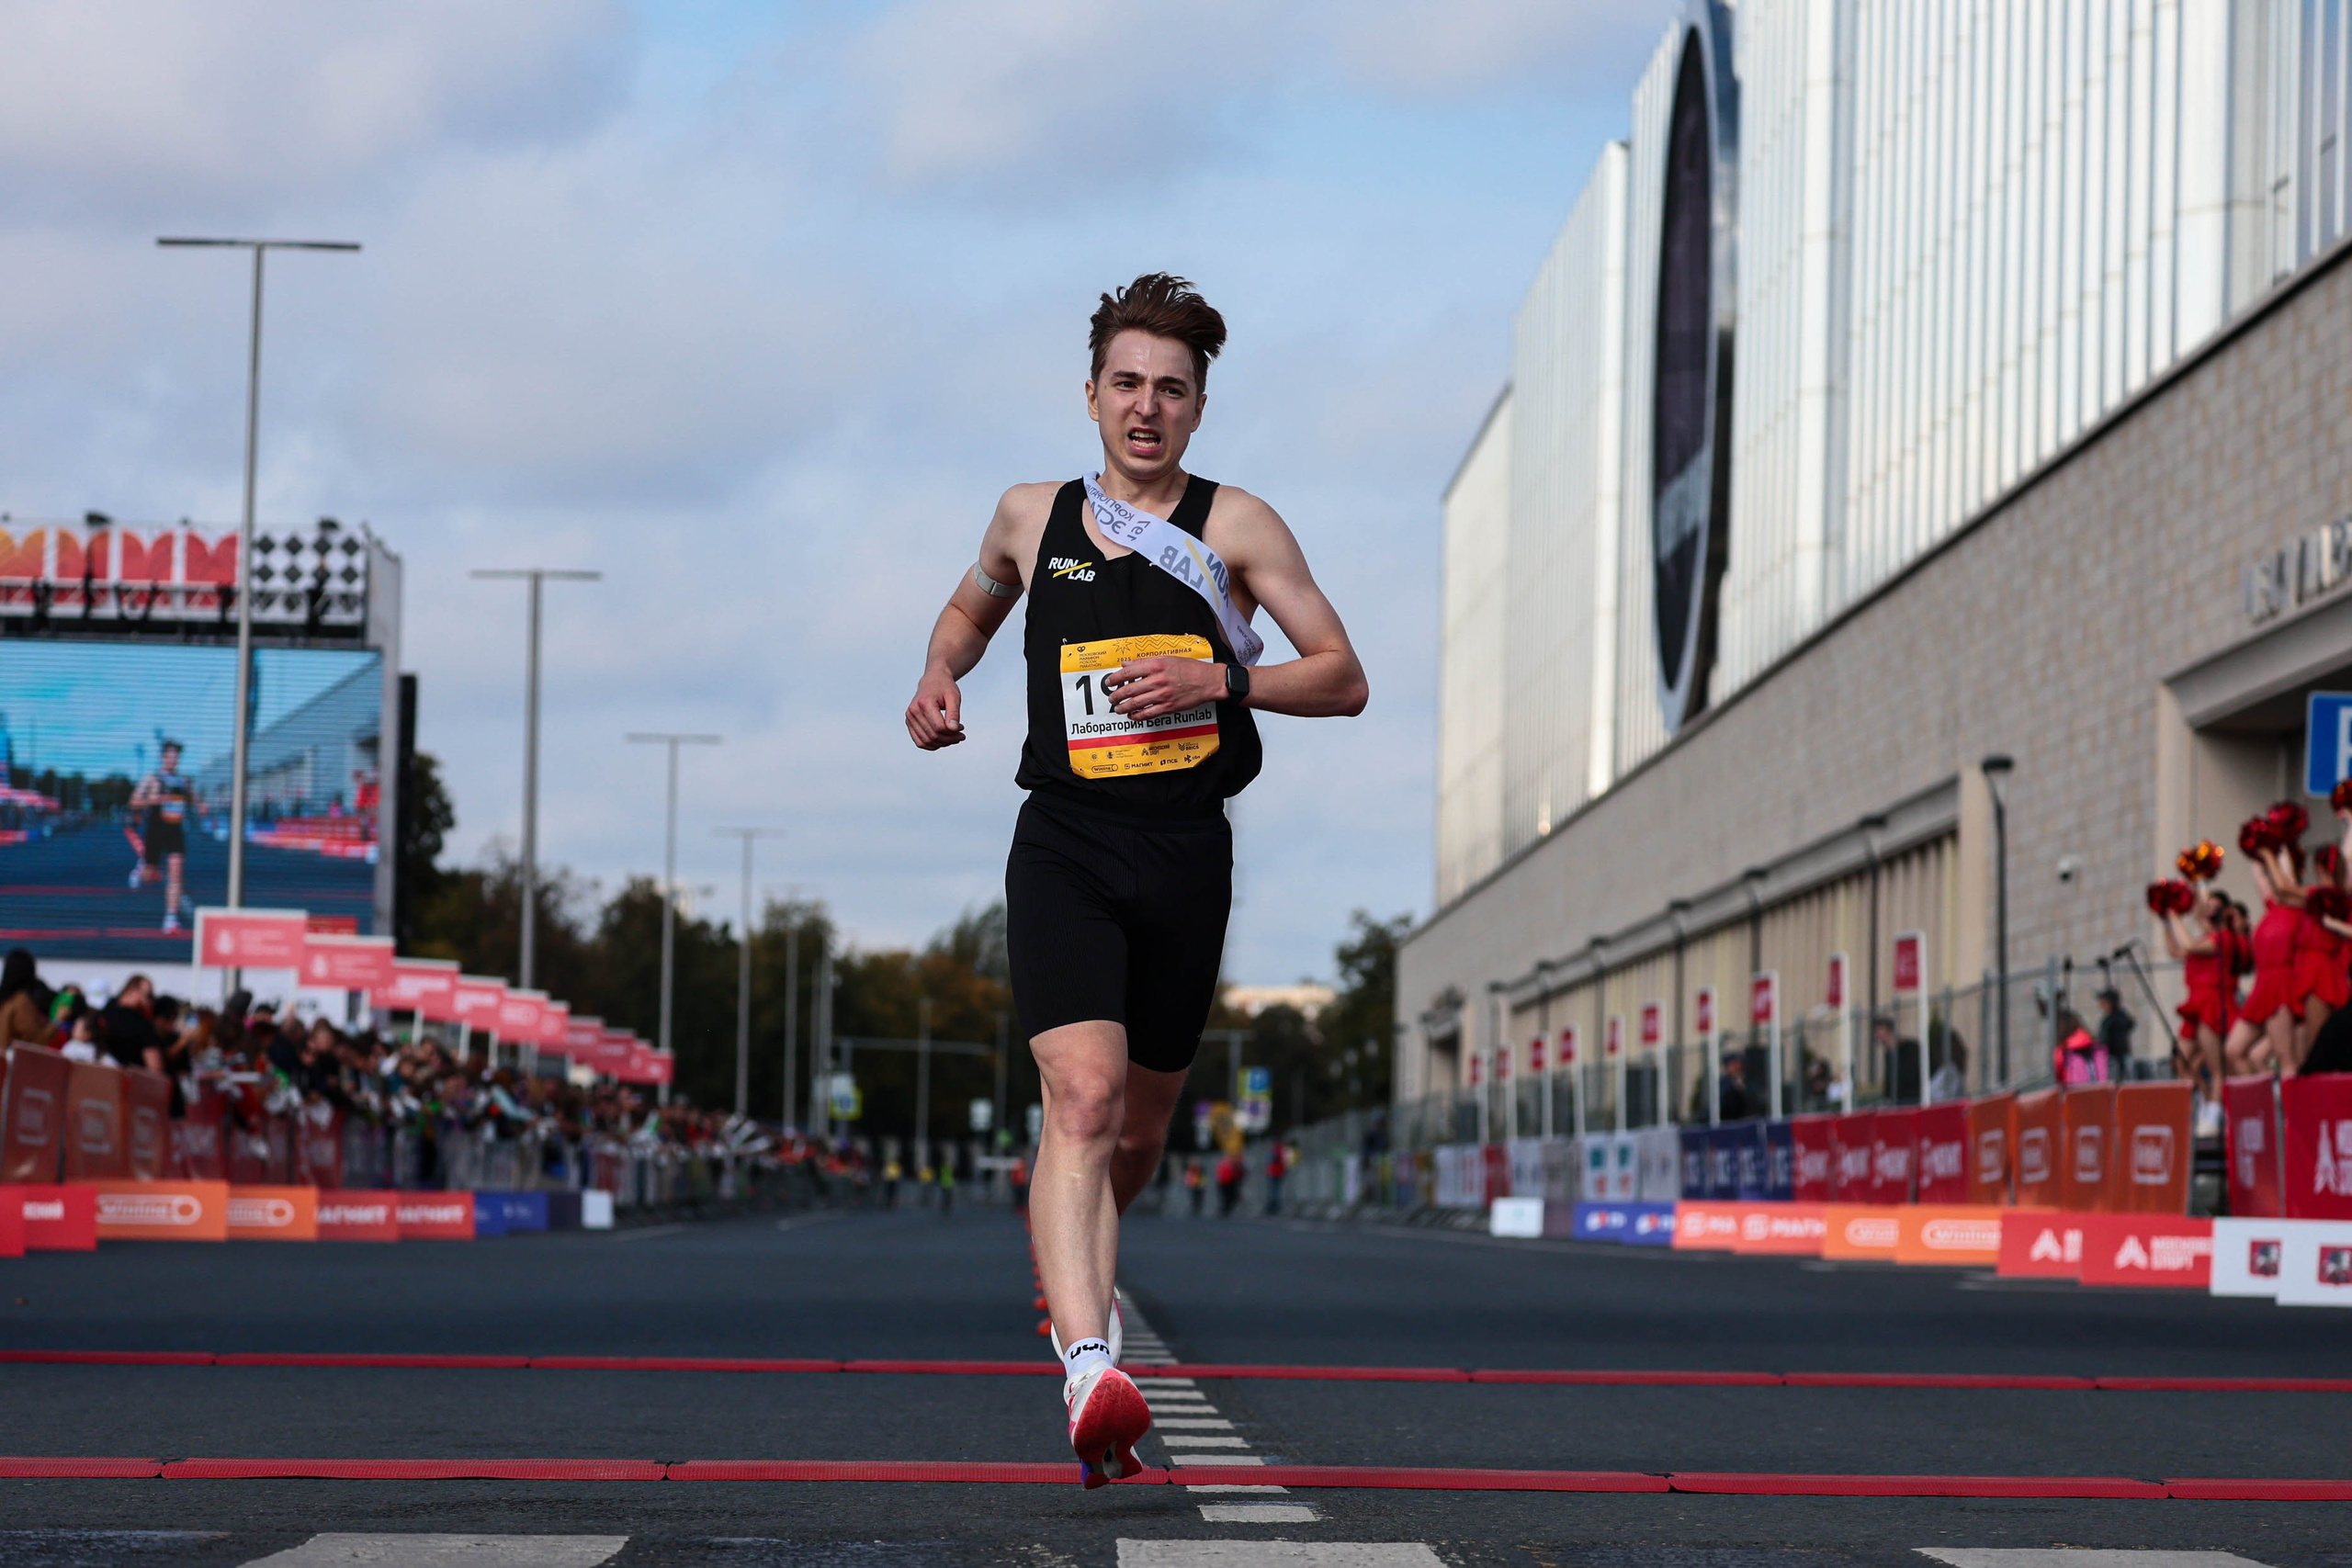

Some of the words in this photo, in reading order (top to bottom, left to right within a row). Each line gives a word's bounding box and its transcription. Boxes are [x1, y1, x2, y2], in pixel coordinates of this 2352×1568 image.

[1047, 557, 1080, 570] RUN
[1068, 569, 1096, 582] LAB
[1136, 648, 1193, 658] КОРПОРАТИВНАЯ
[1070, 719, 1144, 735] Лаборатория
[1174, 708, 1212, 724] Runlab
